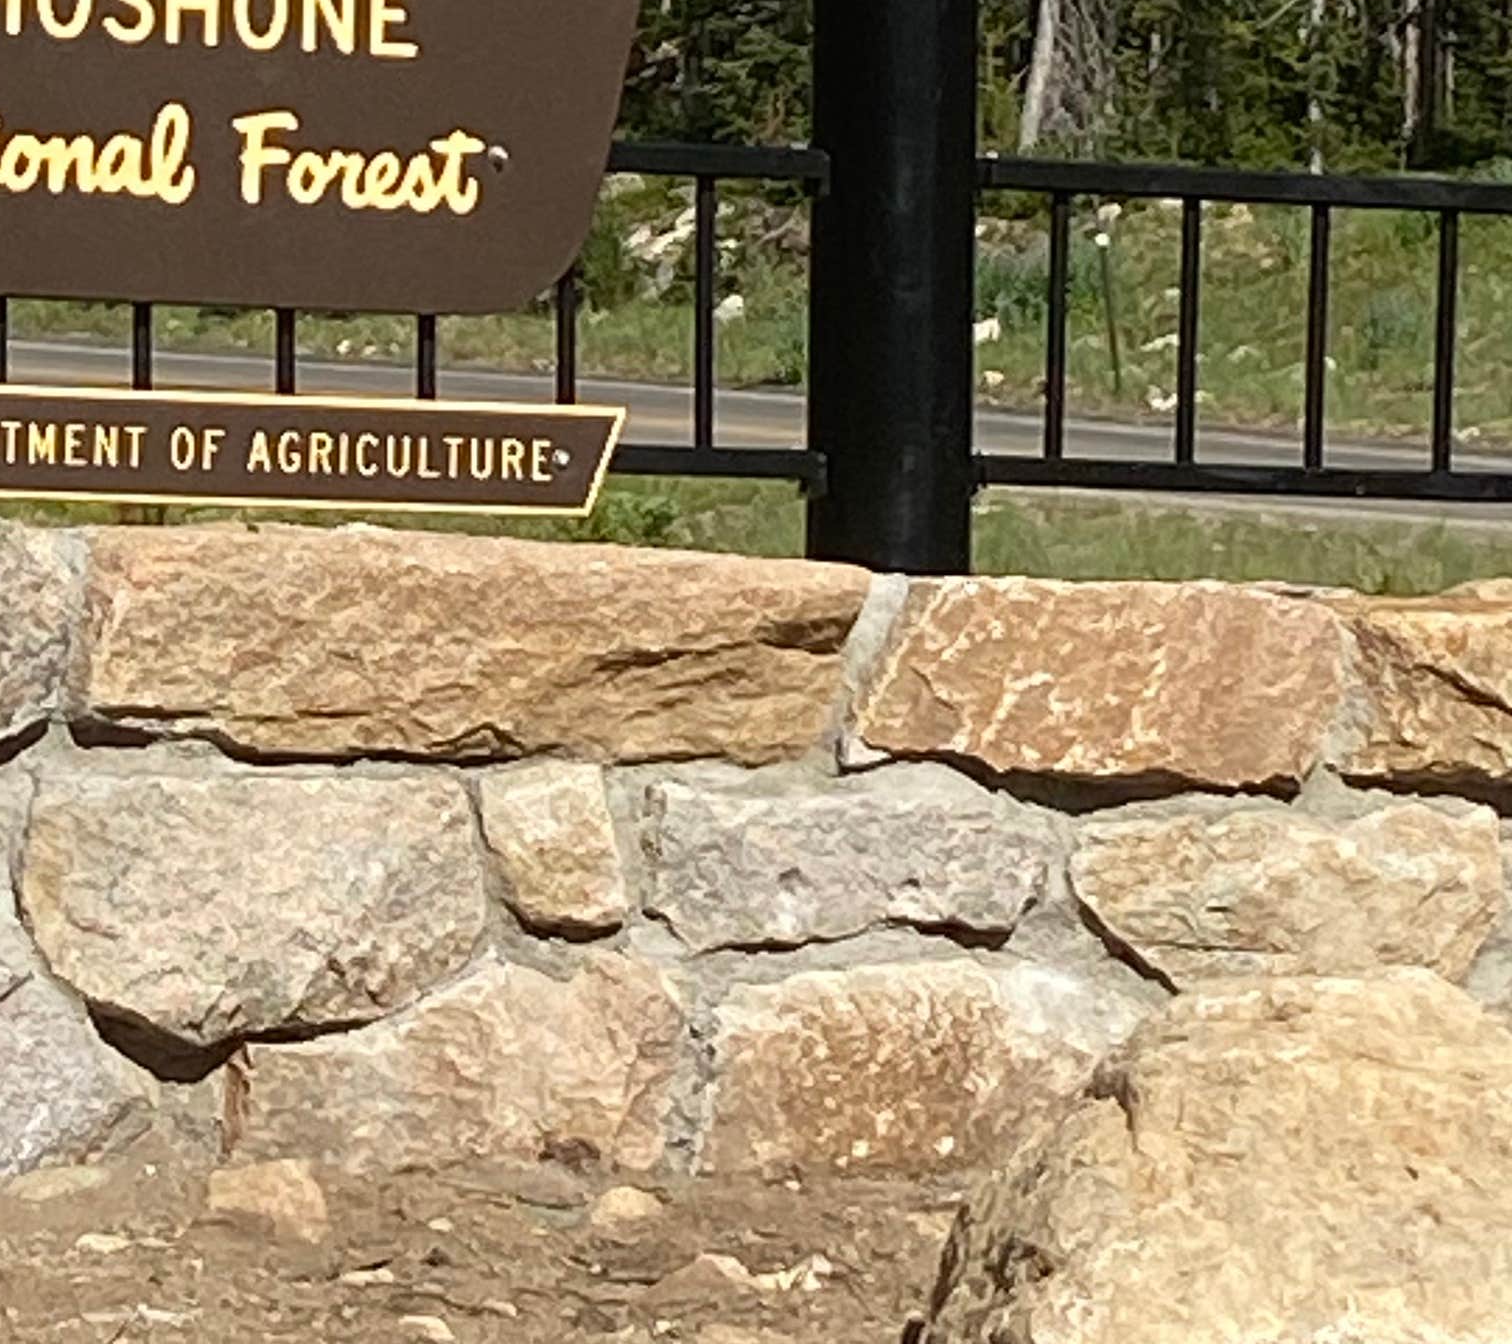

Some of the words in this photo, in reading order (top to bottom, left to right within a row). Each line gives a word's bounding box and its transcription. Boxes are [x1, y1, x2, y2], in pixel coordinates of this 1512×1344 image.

[230, 112, 485, 216] Forest
[169, 425, 225, 471] OF
[247, 430, 553, 482] AGRICULTURE
